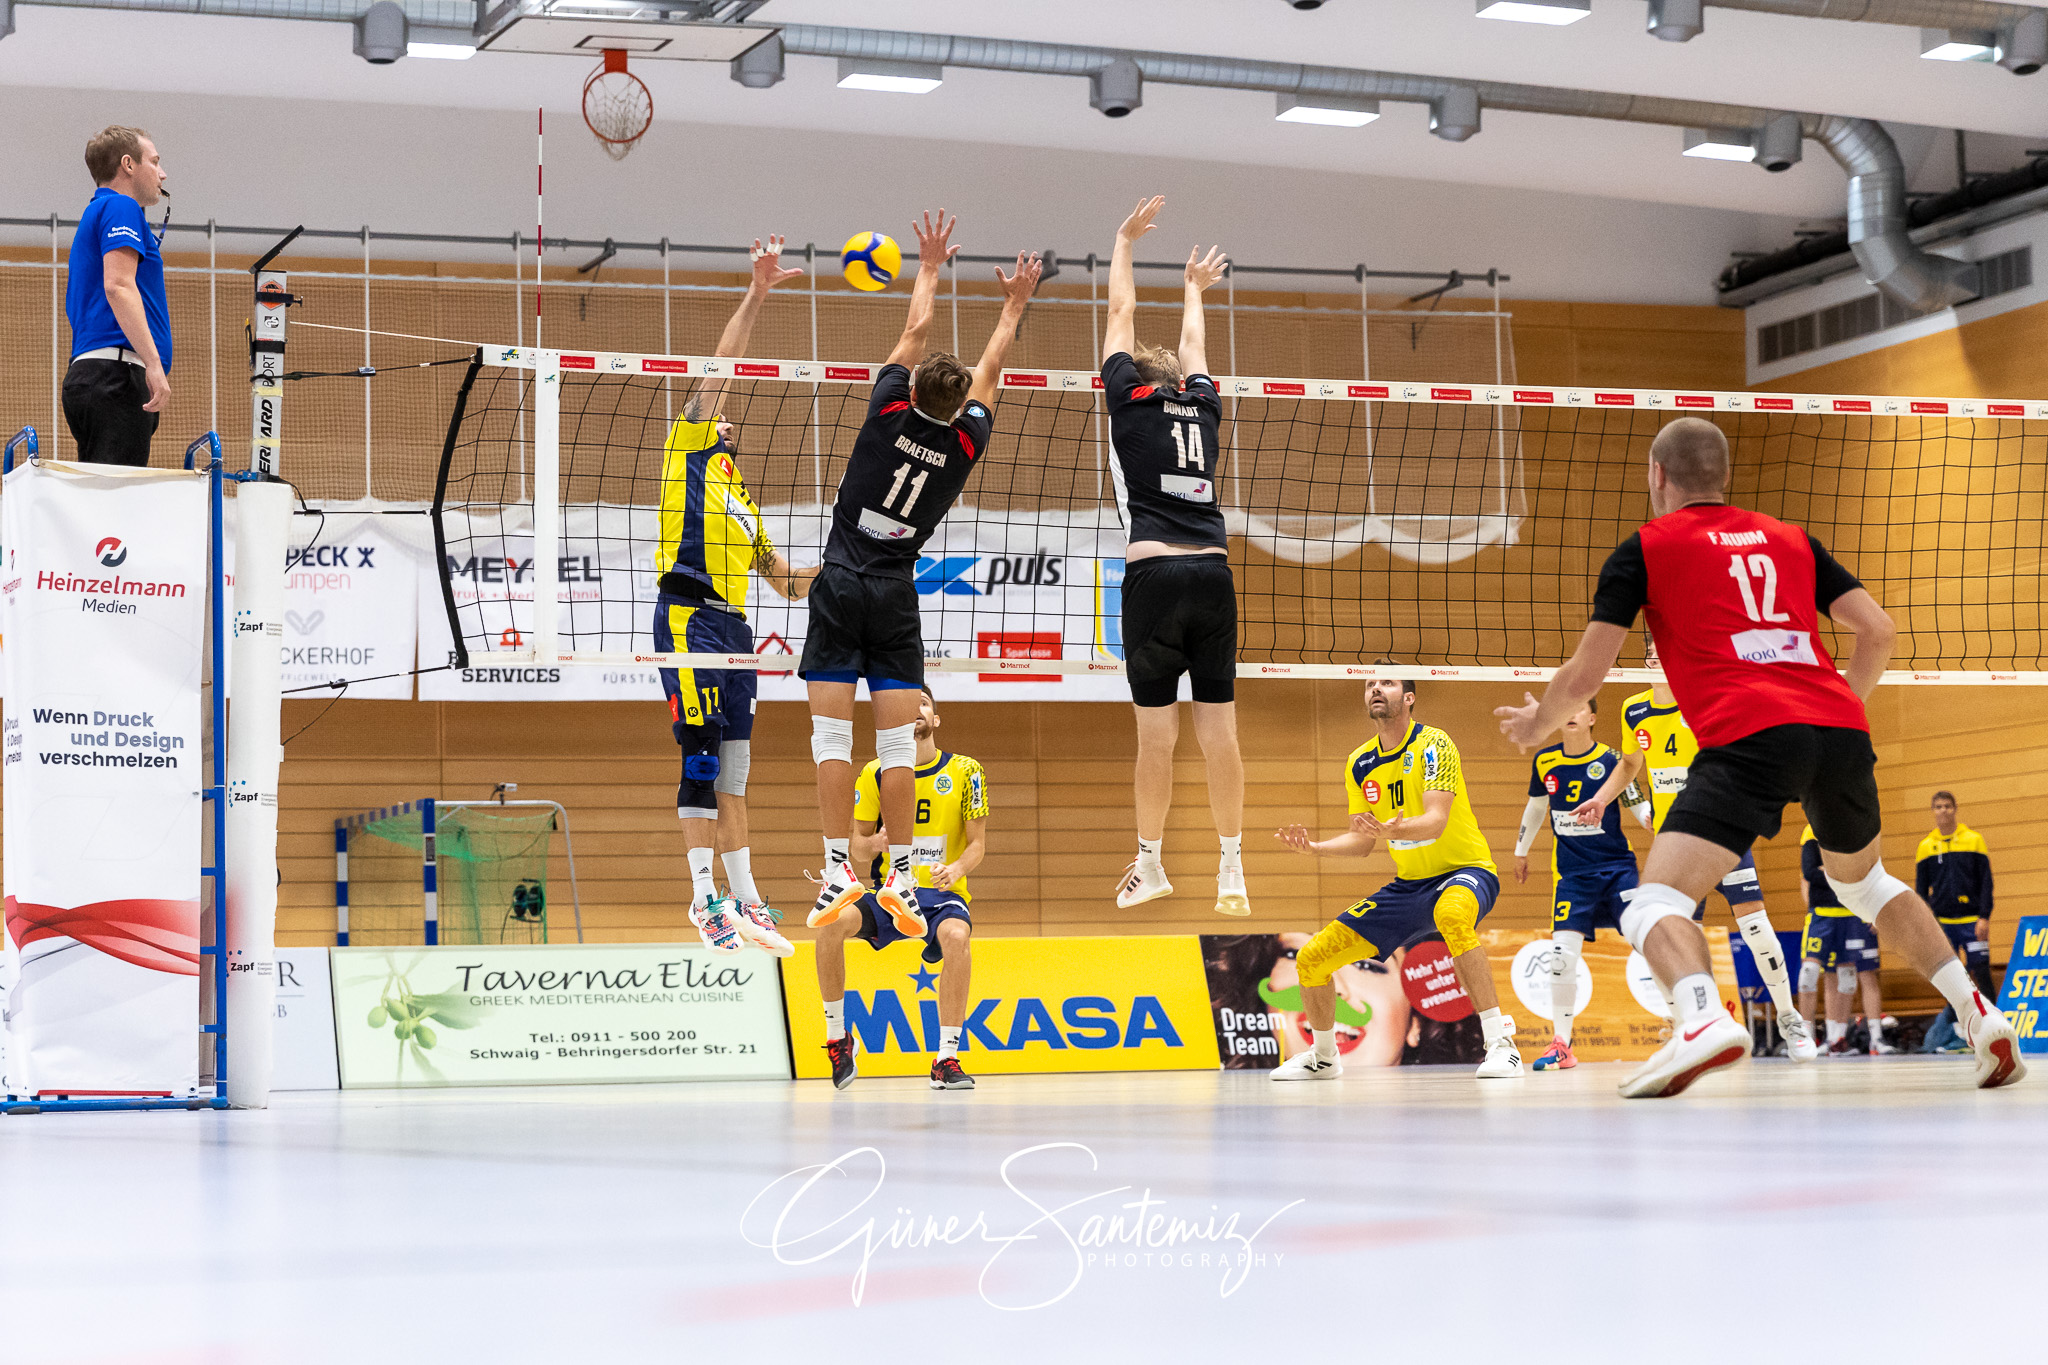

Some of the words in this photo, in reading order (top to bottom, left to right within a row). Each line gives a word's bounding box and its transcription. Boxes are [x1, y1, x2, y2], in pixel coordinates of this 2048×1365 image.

[1163, 400, 1199, 417] BONADT
[258, 399, 273, 474] ERARD
[1171, 422, 1204, 471] 14
[894, 434, 947, 468] BRAETSCH
[882, 462, 929, 518] 11
[286, 546, 348, 567] PECK
[446, 555, 603, 583] MEYEL
[985, 548, 1062, 596] puls
[37, 570, 186, 598] Heinzelmann
[284, 572, 351, 593] umpen
[1728, 554, 1790, 622] 12
[82, 598, 137, 615] Medien
[240, 622, 263, 632] Zapf
[281, 647, 375, 665] CKERHOF
[462, 668, 560, 683] SERVICES
[33, 708, 88, 726] Wenn
[93, 711, 154, 728] Druck
[71, 731, 109, 747] und
[115, 732, 184, 753] Design
[1665, 733, 1677, 756] 4
[40, 751, 178, 769] verschmelzen
[234, 793, 258, 803] Zapf
[1388, 780, 1404, 809] 10
[1566, 780, 1582, 802] 3
[916, 799, 931, 824] 6
[1555, 901, 1572, 921] 3
[2023, 928, 2048, 957] WI
[231, 962, 254, 972] Zapf
[456, 963, 653, 992] Taverna
[1405, 963, 1433, 981] Mehr
[1426, 974, 1456, 991] unter
[2008, 969, 2048, 998] STE
[470, 995, 524, 1006] GREEK
[529, 992, 674, 1005] MEDITERRANEAN
[679, 992, 744, 1003] CUISINE
[1220, 1008, 1287, 1032] Dream
[529, 1032, 565, 1043] Tel.:
[571, 1031, 611, 1042] 0911
[630, 1030, 661, 1041] 500
[667, 1030, 696, 1040] 200
[1222, 1032, 1278, 1056] Team
[470, 1048, 539, 1061] Schwaig
[558, 1045, 698, 1059] Behringersdorfer
[704, 1044, 732, 1055] Str.
[738, 1044, 757, 1055] 21
